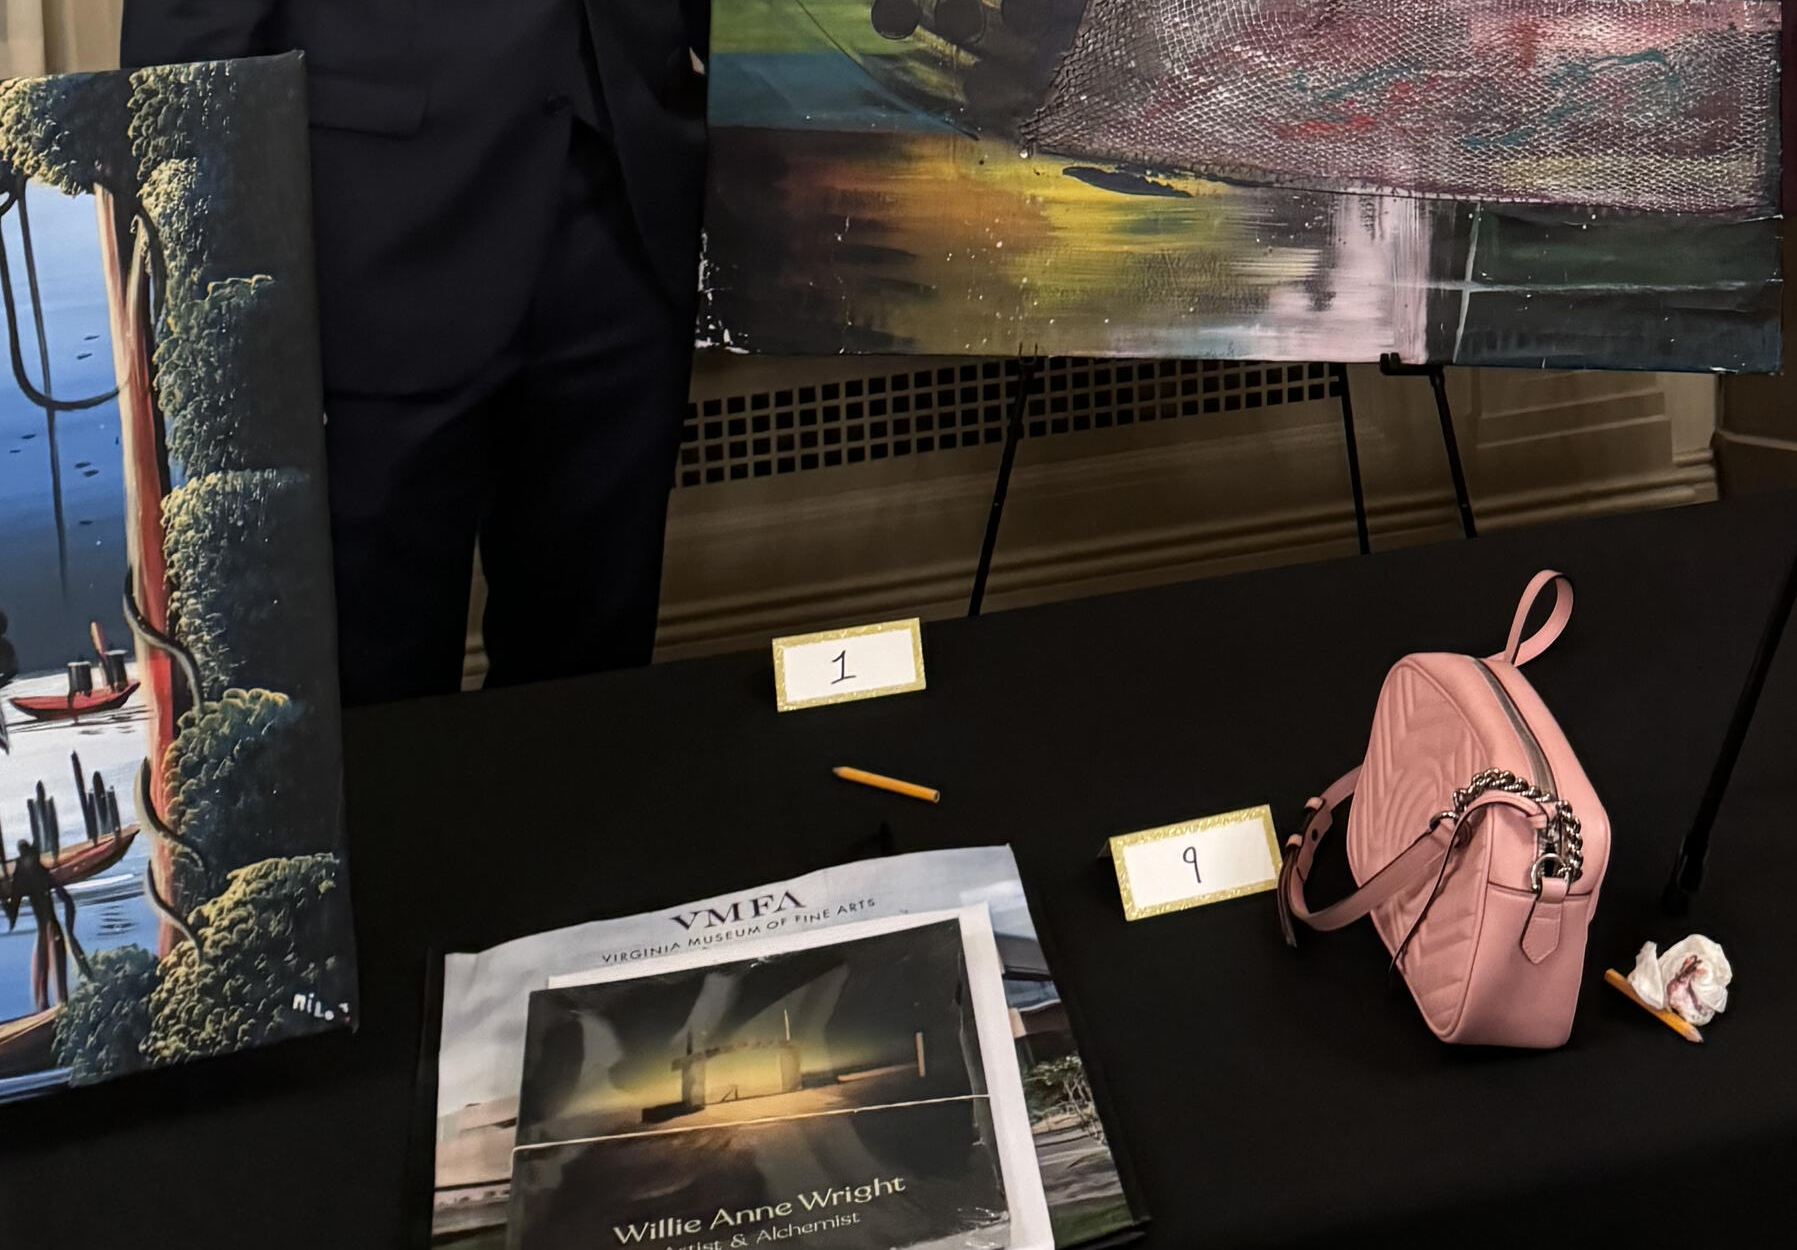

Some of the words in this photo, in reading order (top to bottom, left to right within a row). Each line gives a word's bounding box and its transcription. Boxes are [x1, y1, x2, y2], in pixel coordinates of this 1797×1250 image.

[831, 650, 857, 684] 1
[1182, 846, 1202, 883] 9
[671, 891, 806, 930] VMFA
[602, 942, 680, 963] VIRGINIA
[688, 925, 761, 946] MUSEUM
[766, 918, 787, 930] OF
[795, 909, 830, 924] FINE
[836, 898, 876, 916] ARTS
[612, 1216, 702, 1244] Willie
[709, 1202, 793, 1231] Anne
[798, 1177, 906, 1211] Wright
[664, 1241, 723, 1250] tist
[730, 1233, 748, 1248] &
[756, 1212, 861, 1244] Alchemist
